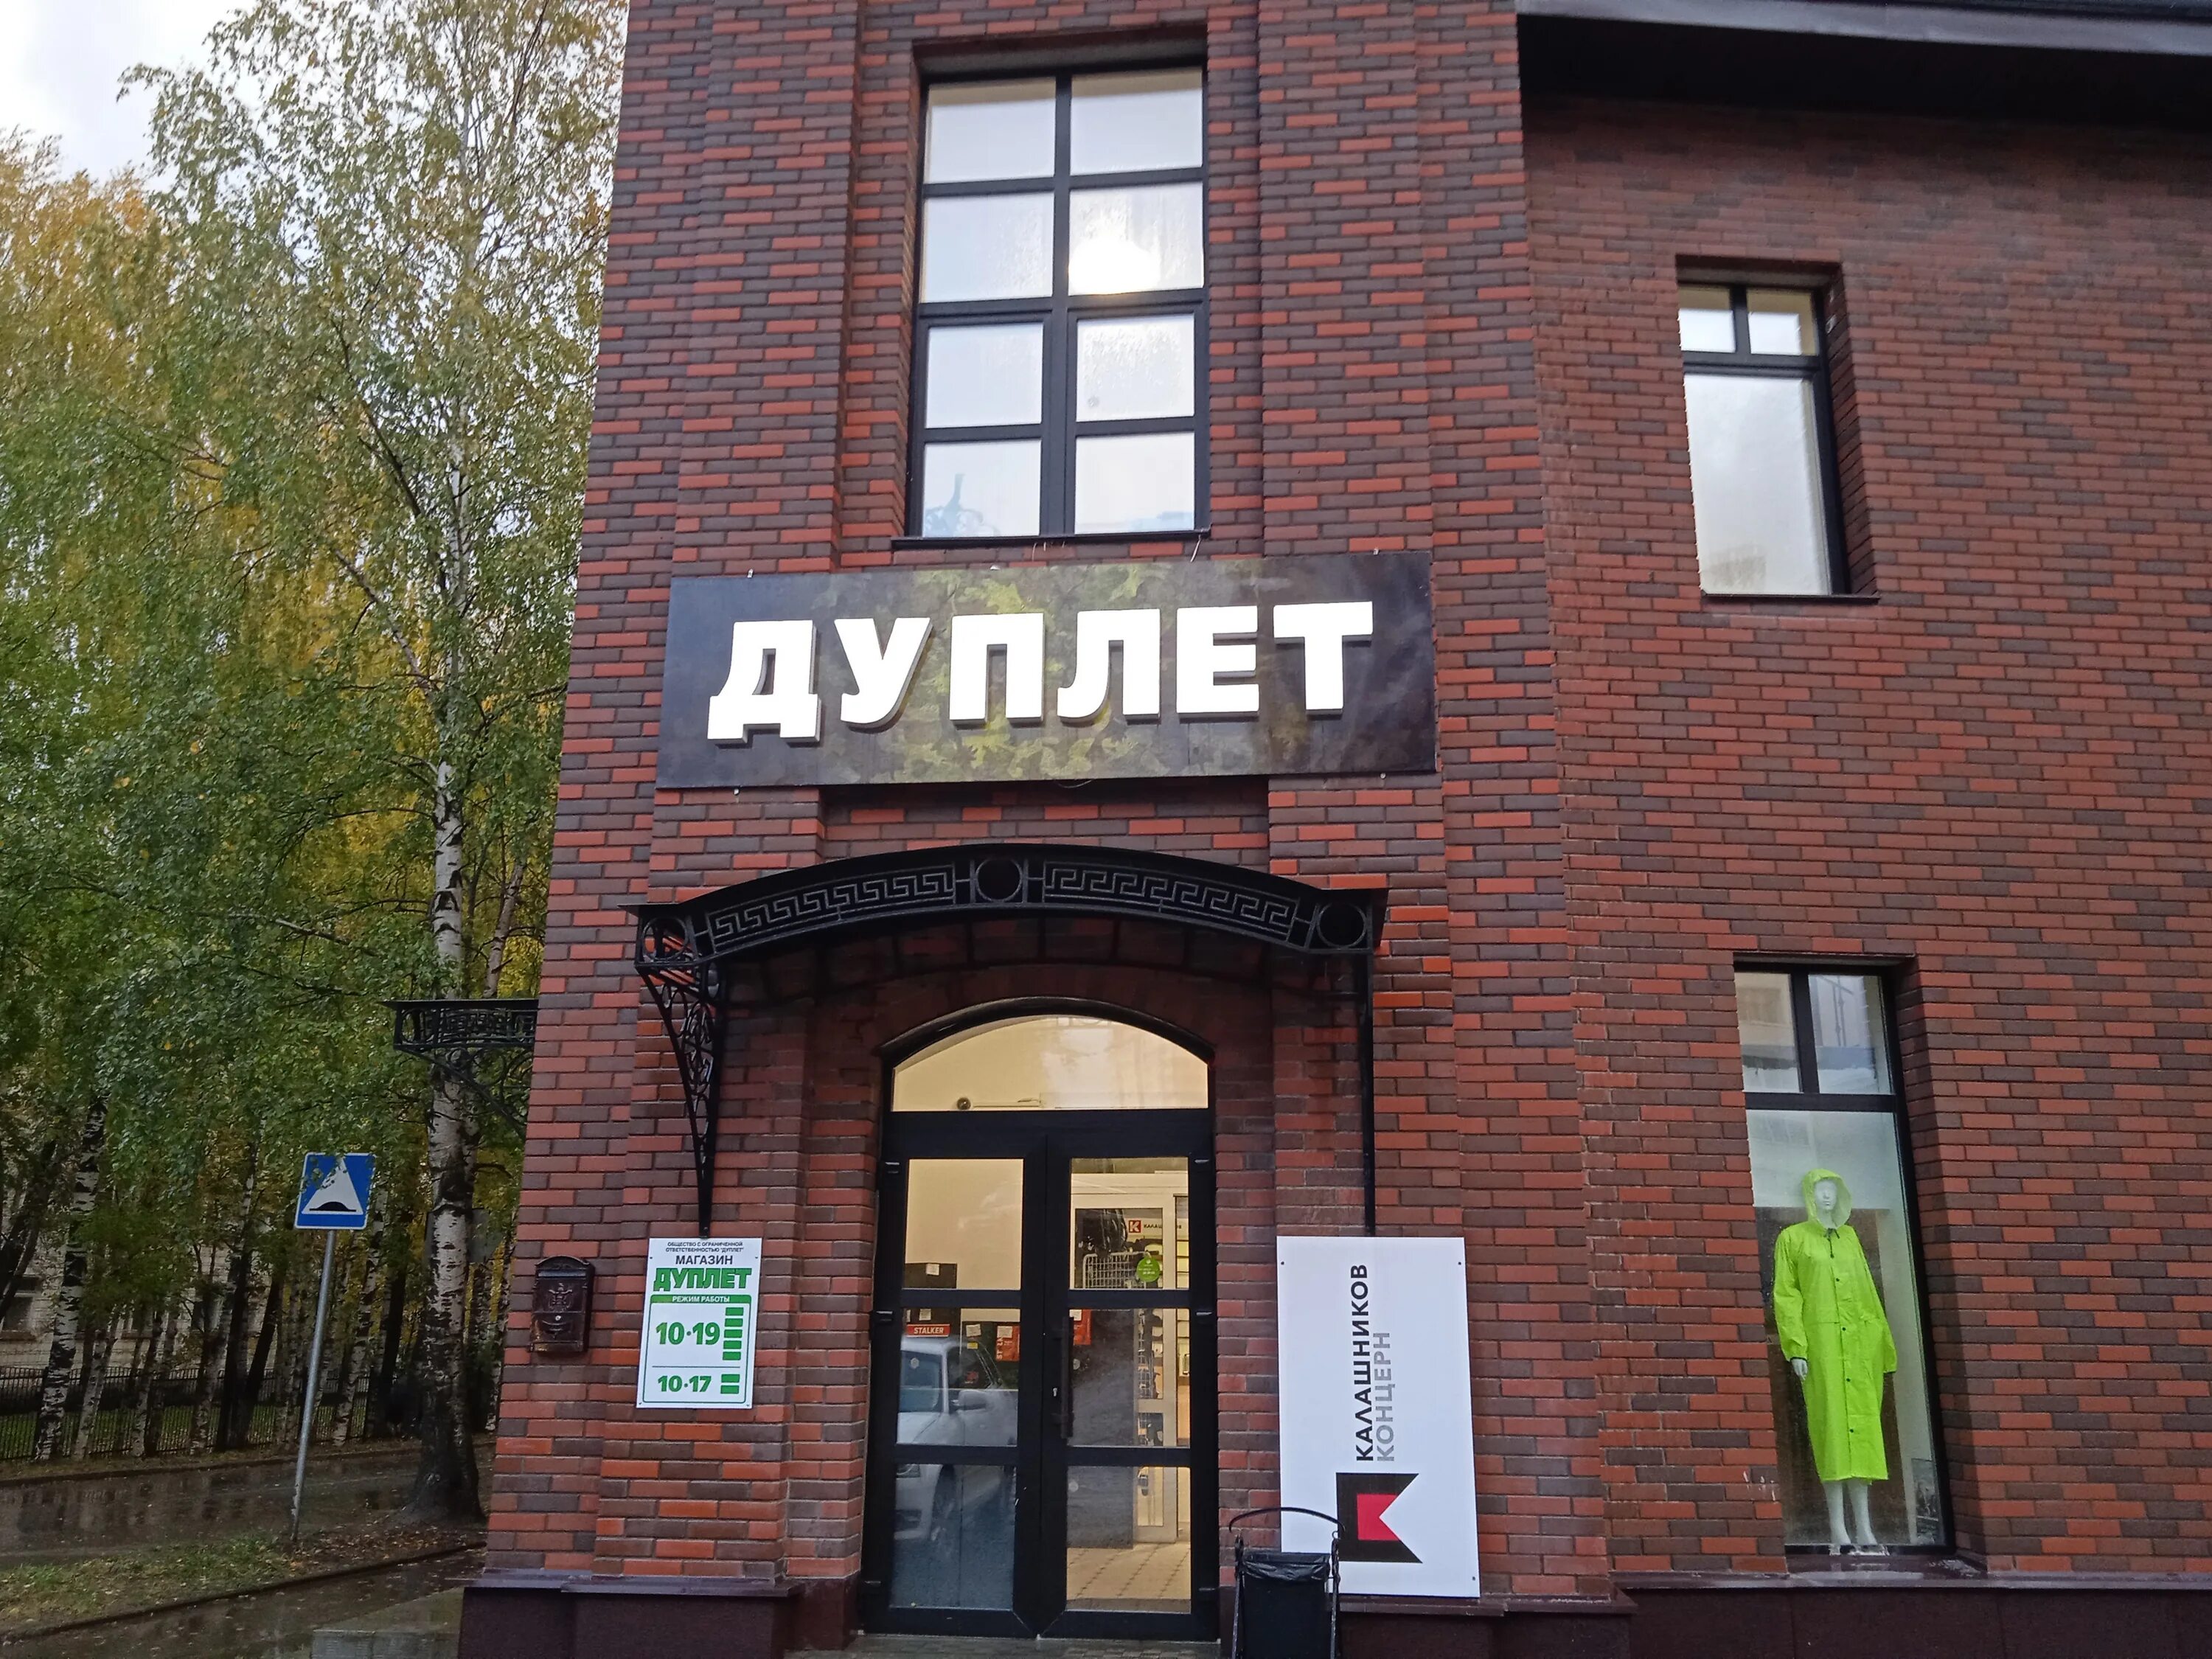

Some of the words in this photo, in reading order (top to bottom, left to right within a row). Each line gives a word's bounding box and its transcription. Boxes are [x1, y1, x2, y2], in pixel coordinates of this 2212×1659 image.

[706, 600, 1374, 745] ДУПЛЕТ
[653, 1267, 752, 1292] ДУПЛЕТ
[675, 1255, 733, 1265] МАГАЗИН
[914, 1326, 945, 1335] STALKER
[1350, 1264, 1374, 1461] КАЛАШНИКОВ
[1373, 1332, 1396, 1462] КОНЦЕРН
